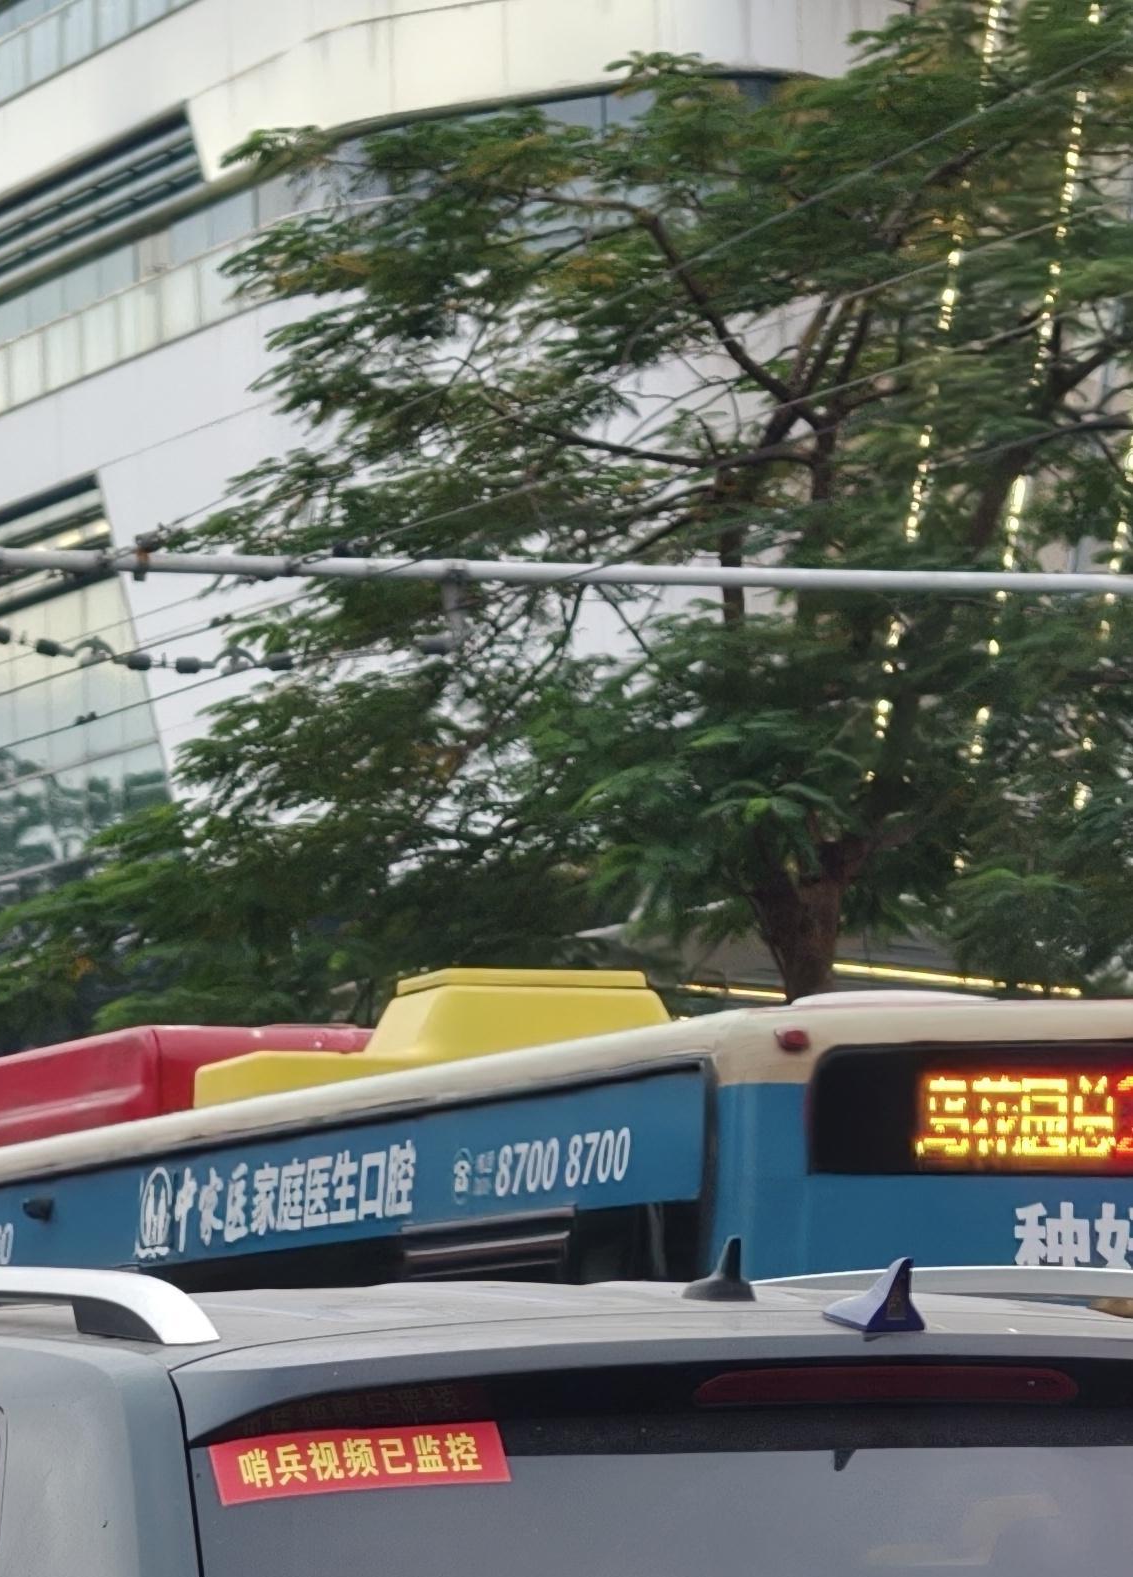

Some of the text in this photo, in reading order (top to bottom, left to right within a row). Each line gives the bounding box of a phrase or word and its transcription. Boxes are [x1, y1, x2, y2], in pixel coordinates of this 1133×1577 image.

[495, 1136, 560, 1197] 8700
[565, 1126, 631, 1188] 8700
[237, 1432, 483, 1488] 哨兵视频已监控
